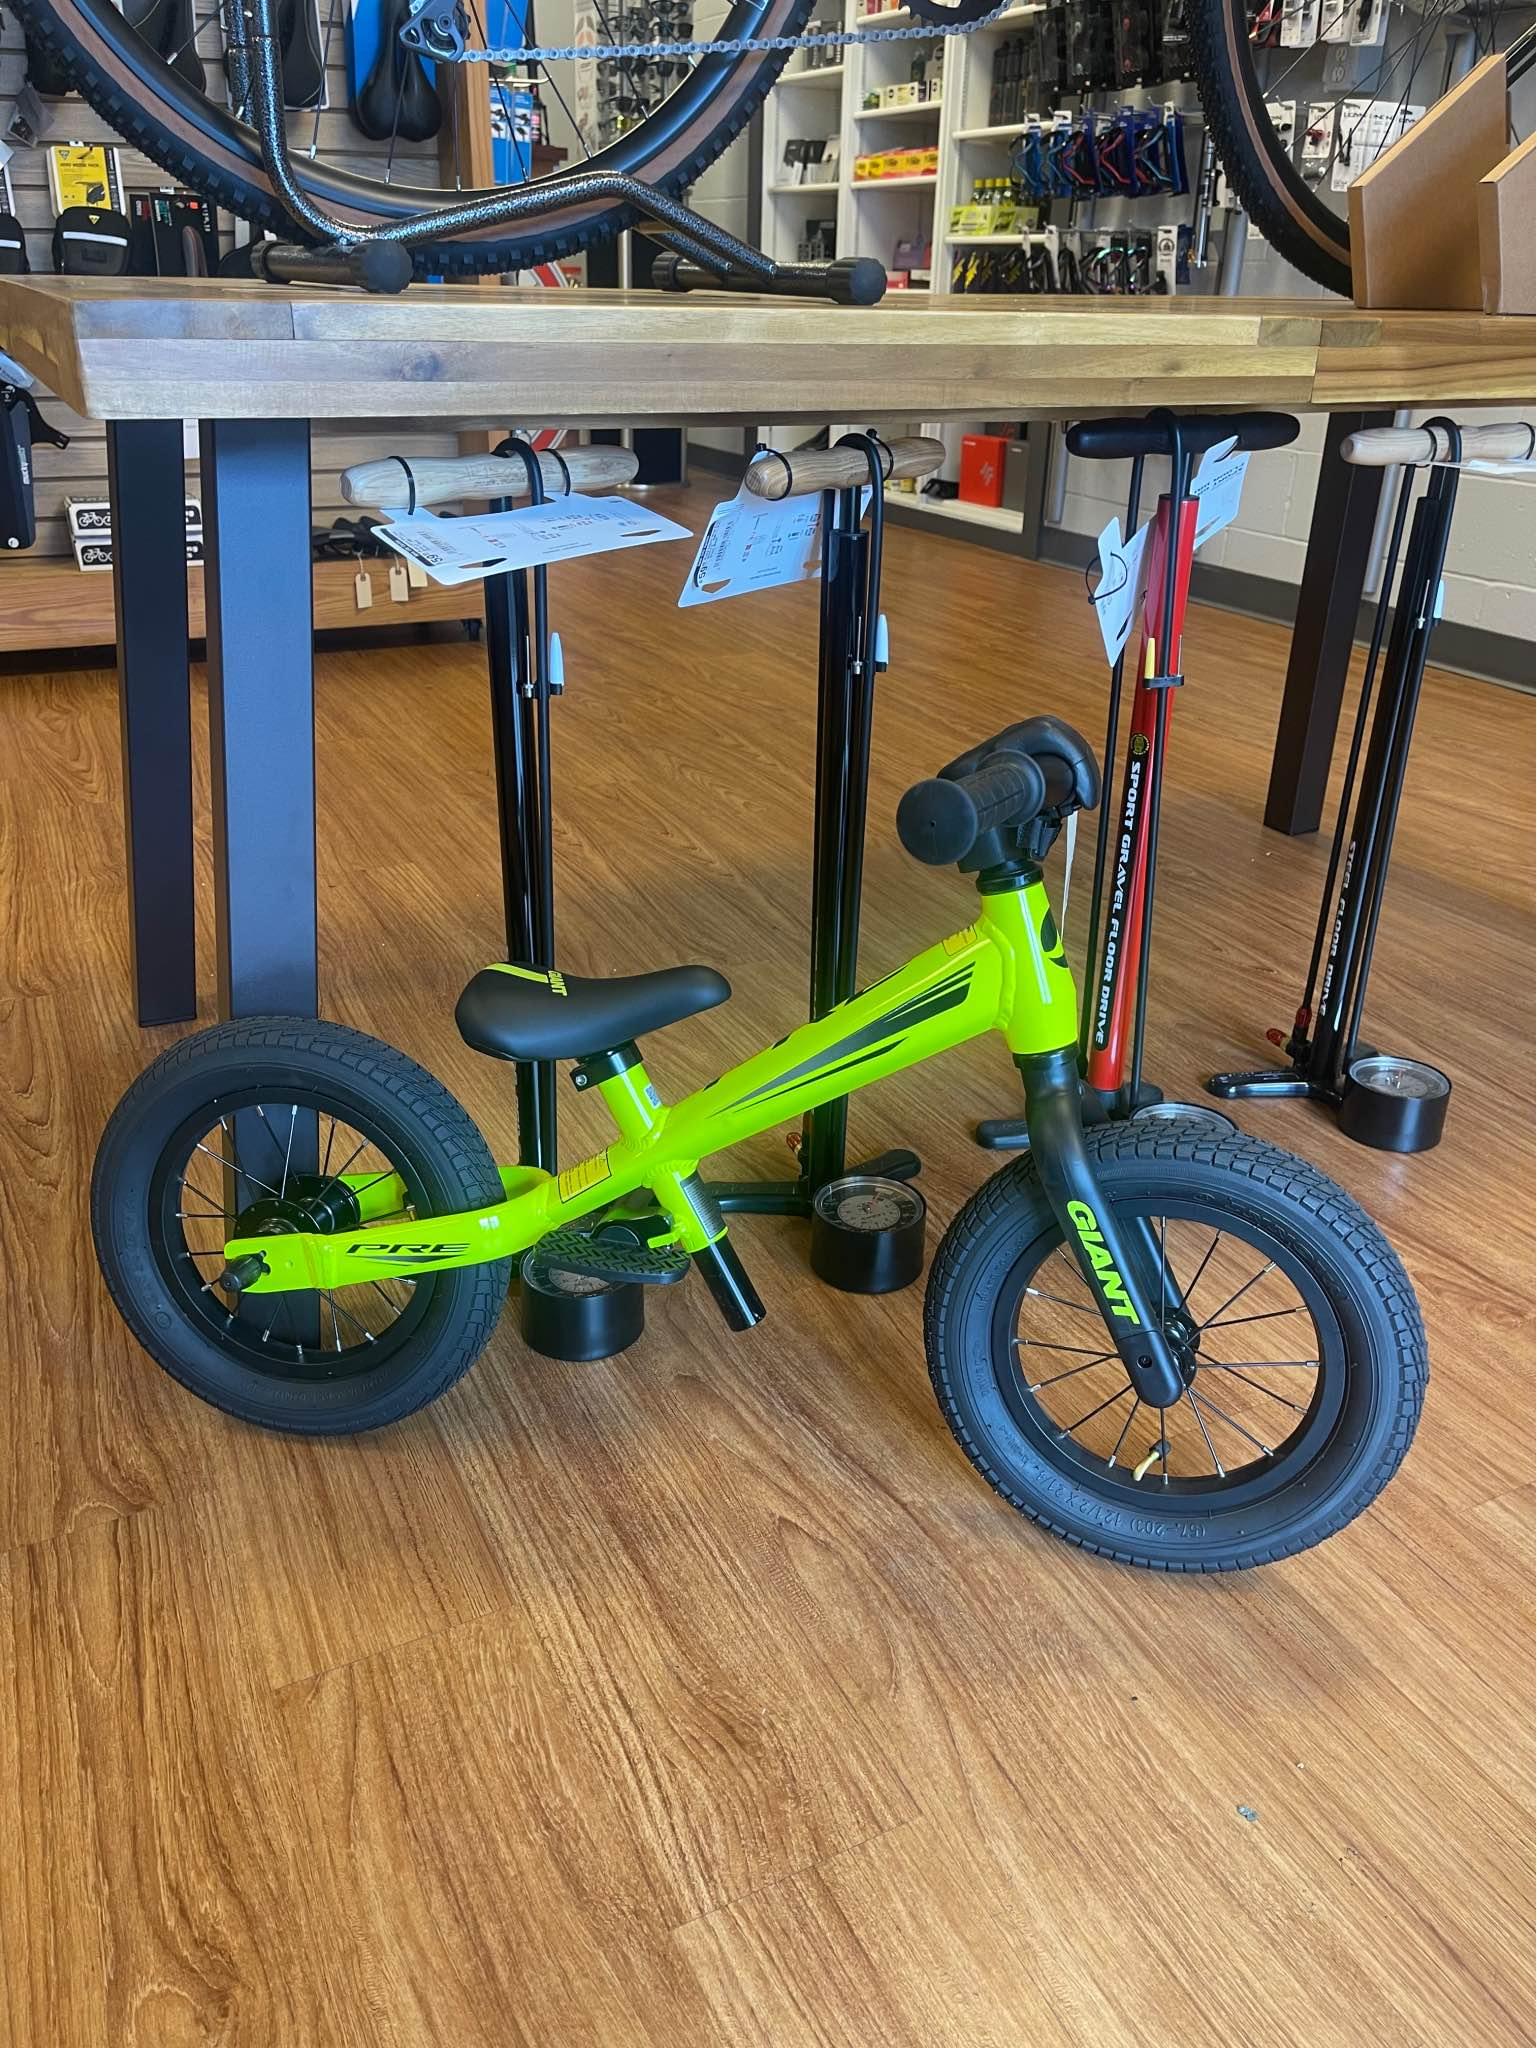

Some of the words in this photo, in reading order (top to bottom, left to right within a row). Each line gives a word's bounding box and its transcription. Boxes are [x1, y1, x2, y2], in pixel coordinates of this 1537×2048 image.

[1124, 760, 1141, 830] SPORT
[1111, 834, 1132, 914] GRAVEL
[1342, 840, 1357, 890] STEEL
[1102, 919, 1120, 982] FLOOR
[1329, 897, 1346, 958] FLOOR
[1094, 986, 1111, 1044] DRIVE
[1319, 963, 1335, 1017] DRIVE
[345, 1243, 472, 1254] PRE
[1066, 1200, 1141, 1325] GIANT
